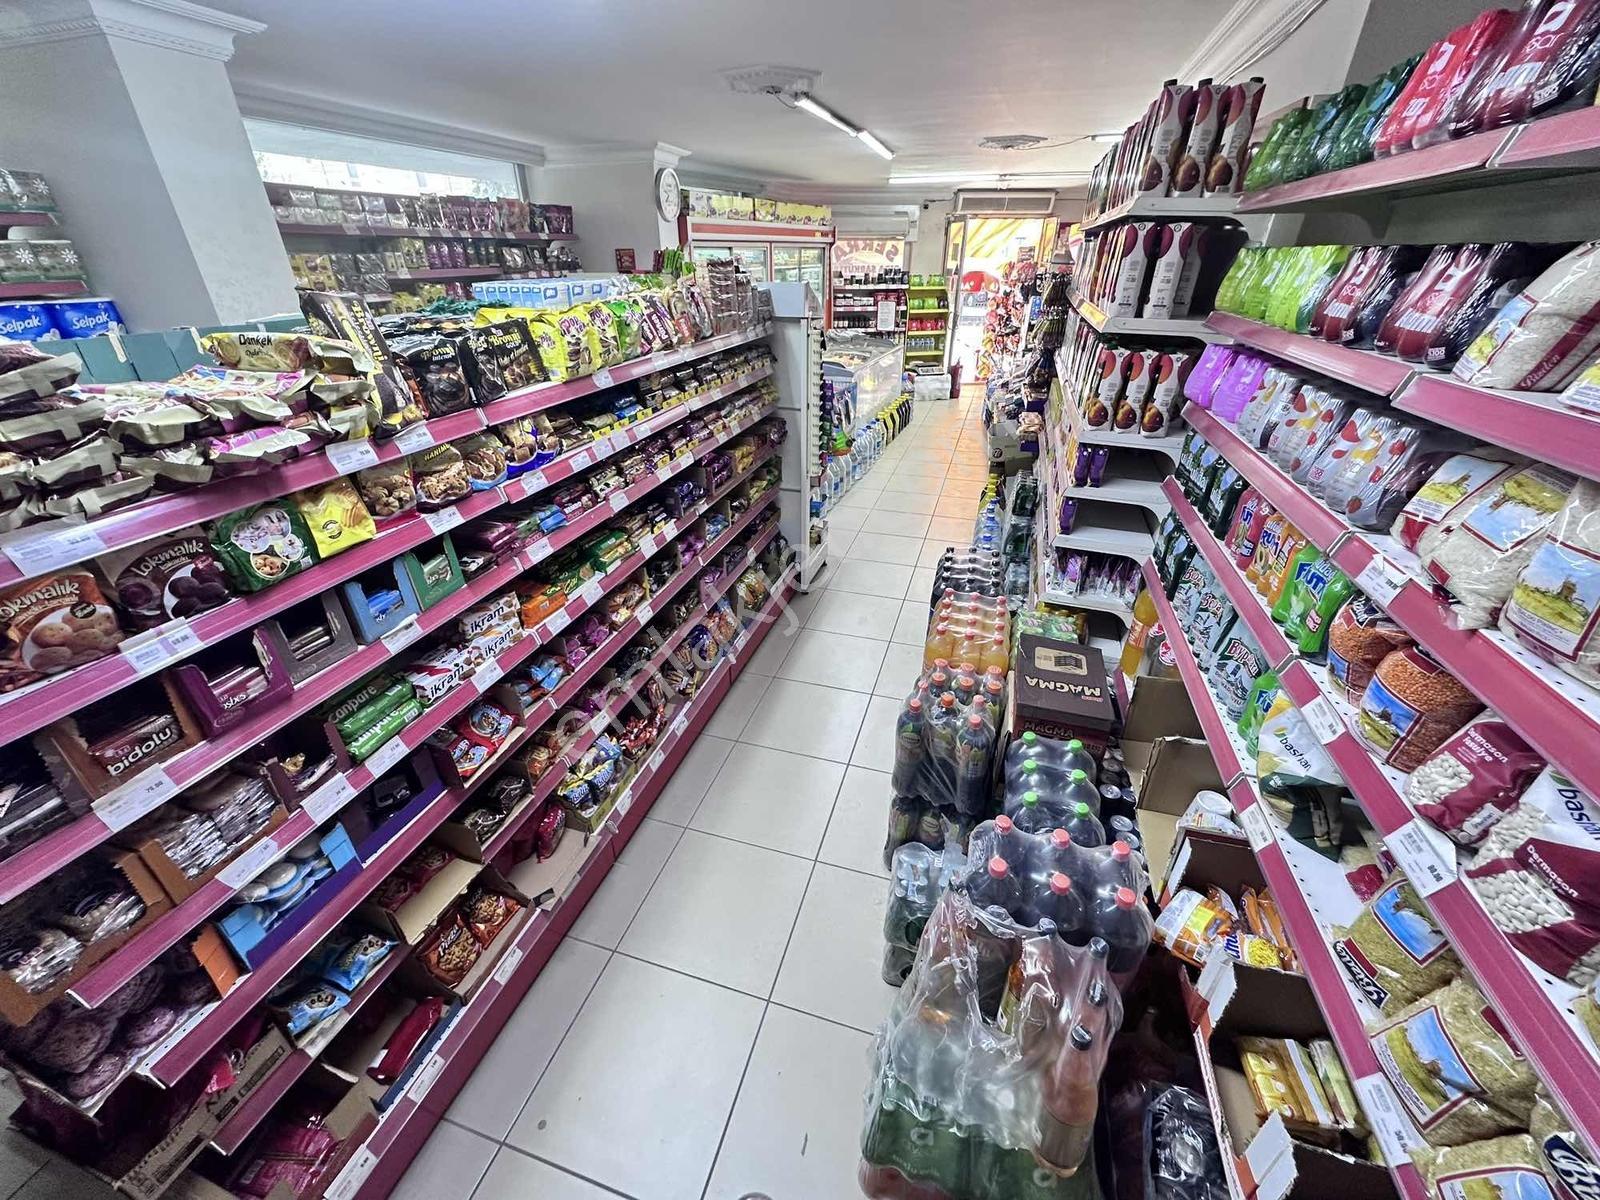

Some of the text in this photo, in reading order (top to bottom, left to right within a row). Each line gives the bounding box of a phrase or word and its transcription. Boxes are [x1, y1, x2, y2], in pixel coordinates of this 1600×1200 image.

[0, 315, 41, 334] Selpak
[73, 311, 110, 329] Selpak
[239, 333, 272, 347] Dankek
[488, 330, 522, 347] Browni
[130, 539, 204, 577] Lokmalık
[0, 579, 80, 620] okmalık
[470, 606, 504, 633] ikram
[484, 628, 515, 657] ikram
[429, 665, 465, 698] ikram
[1024, 674, 1101, 698] MAGMA
[1024, 721, 1074, 738] MAGMA
[106, 727, 172, 777] bidolu
[1526, 843, 1579, 898] Dermason
